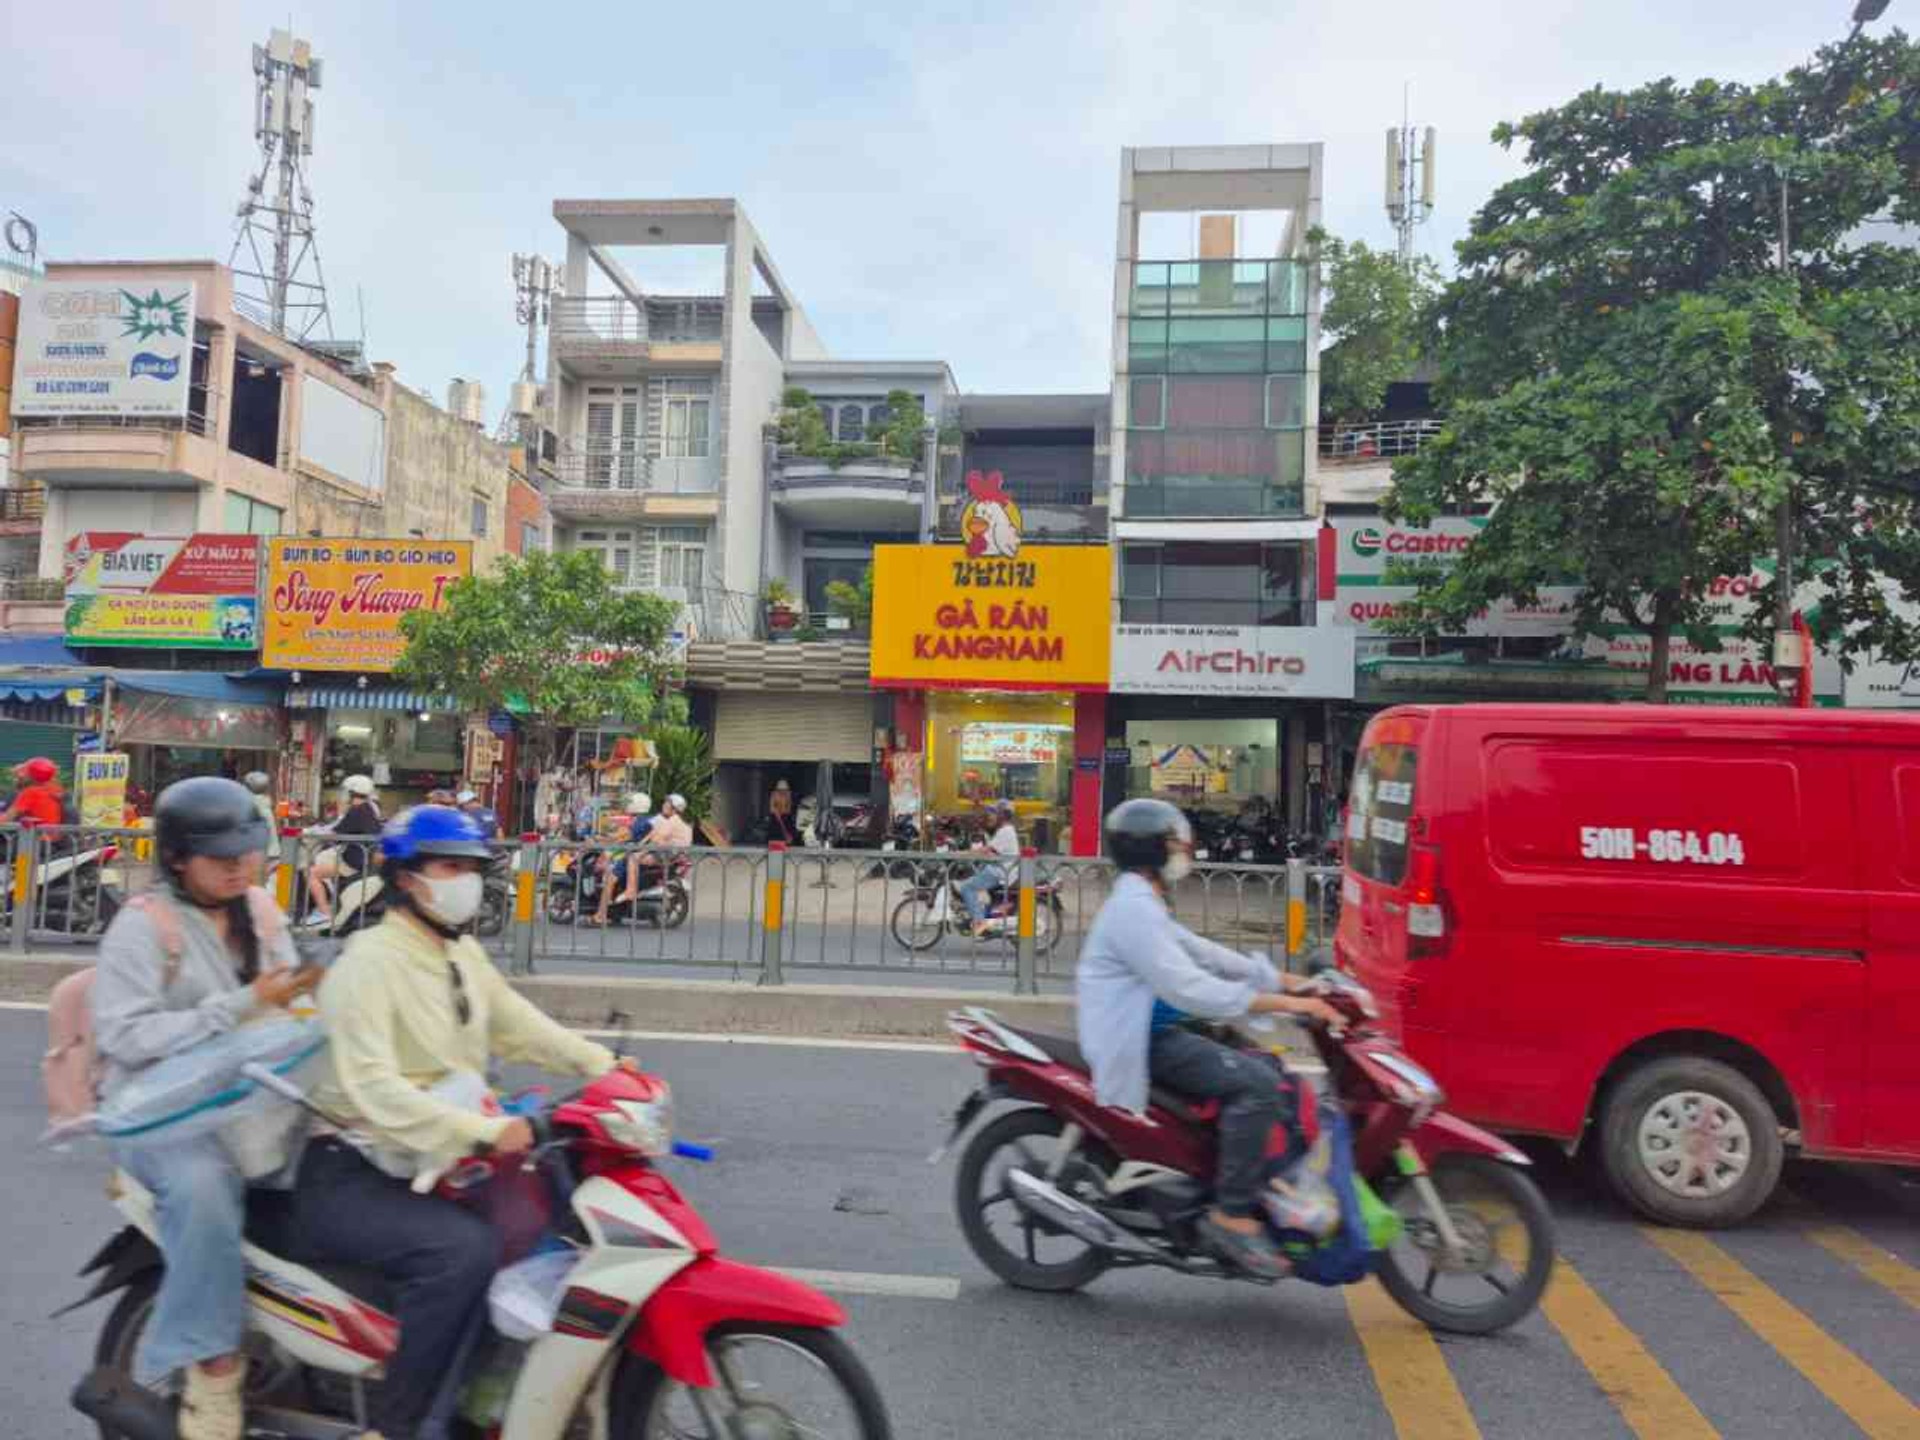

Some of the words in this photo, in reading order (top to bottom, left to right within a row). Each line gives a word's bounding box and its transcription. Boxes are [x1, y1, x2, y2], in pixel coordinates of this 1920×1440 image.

[1386, 533, 1471, 553] Castro
[936, 598, 978, 629] GÀ
[989, 600, 1048, 631] RÁN
[1699, 601, 1734, 615] oint
[914, 634, 1063, 661] KANGNAM
[1581, 827, 1745, 865] 50H-864.04
